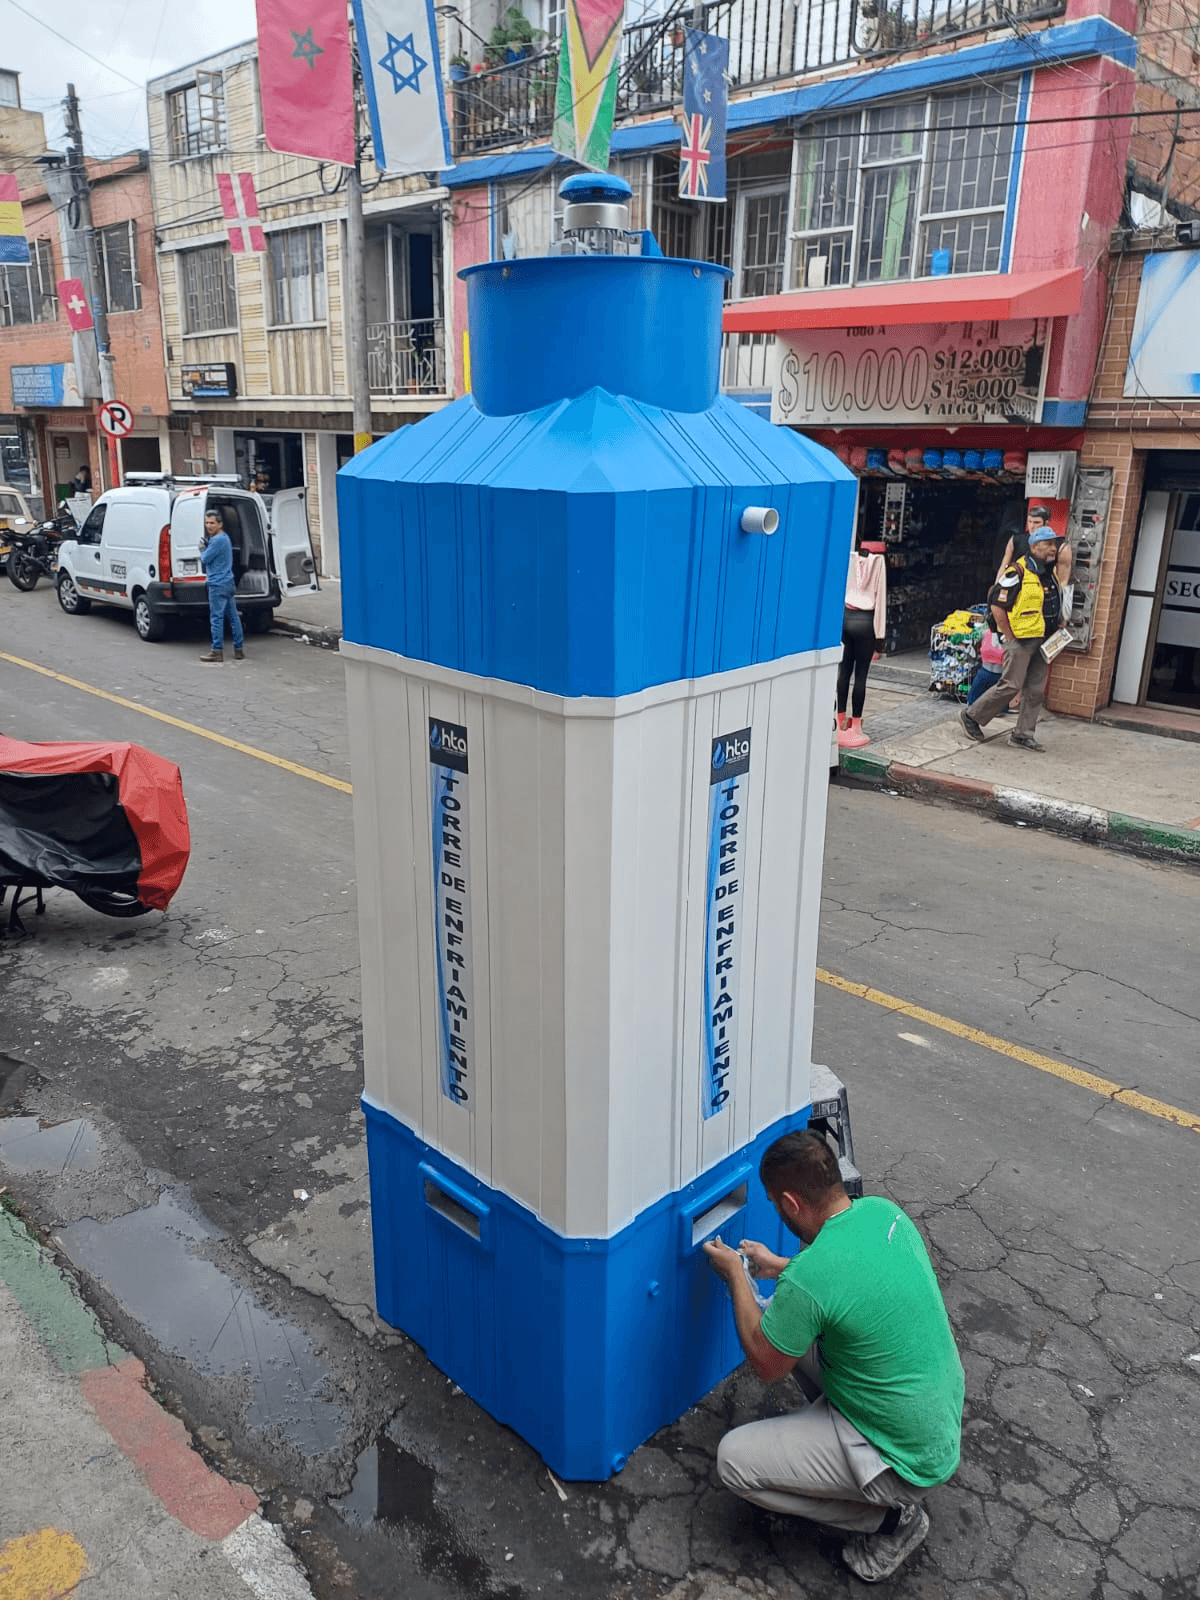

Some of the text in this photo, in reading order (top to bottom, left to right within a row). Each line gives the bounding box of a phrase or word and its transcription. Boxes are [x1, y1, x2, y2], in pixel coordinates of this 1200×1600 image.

[933, 348, 1022, 371] $12.000
[779, 346, 930, 419] $10.000
[930, 377, 1018, 400] $15.000
[110, 406, 126, 431] P
[923, 402, 933, 416] Y
[937, 402, 978, 417] ALGO
[441, 727, 467, 753] hta
[725, 738, 749, 759] hta
[440, 775, 462, 868] TORRE
[719, 784, 740, 876] TORRE
[441, 871, 466, 894] DE
[714, 879, 739, 901] DE
[445, 896, 469, 1101] ENFRIAMIENTO
[710, 904, 735, 1107] ENFRIAMIENTO
